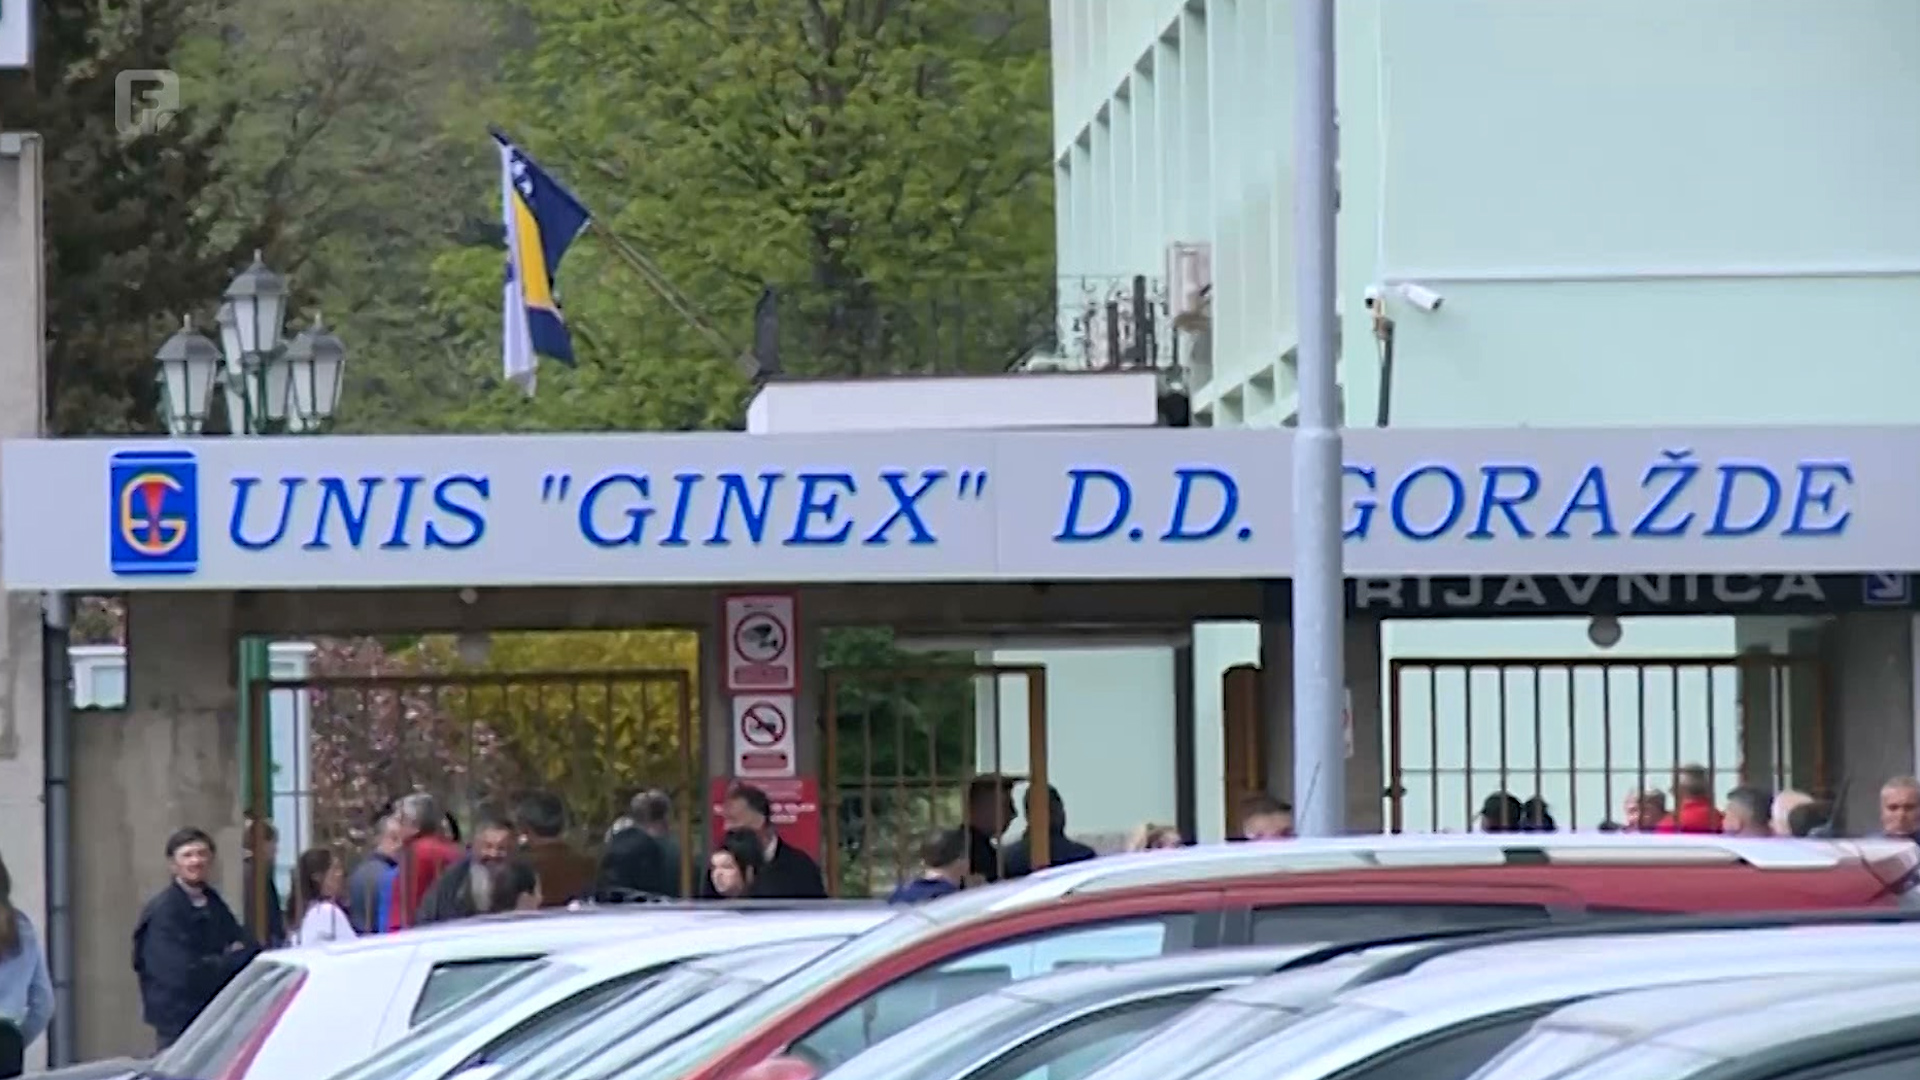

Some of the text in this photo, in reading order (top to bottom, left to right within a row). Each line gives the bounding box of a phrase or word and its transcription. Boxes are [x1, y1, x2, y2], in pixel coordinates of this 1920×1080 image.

[229, 449, 1855, 550] UNIS "GINEX" D.D. GORAŽDE
[1356, 575, 1826, 608] RIJAVNICA
